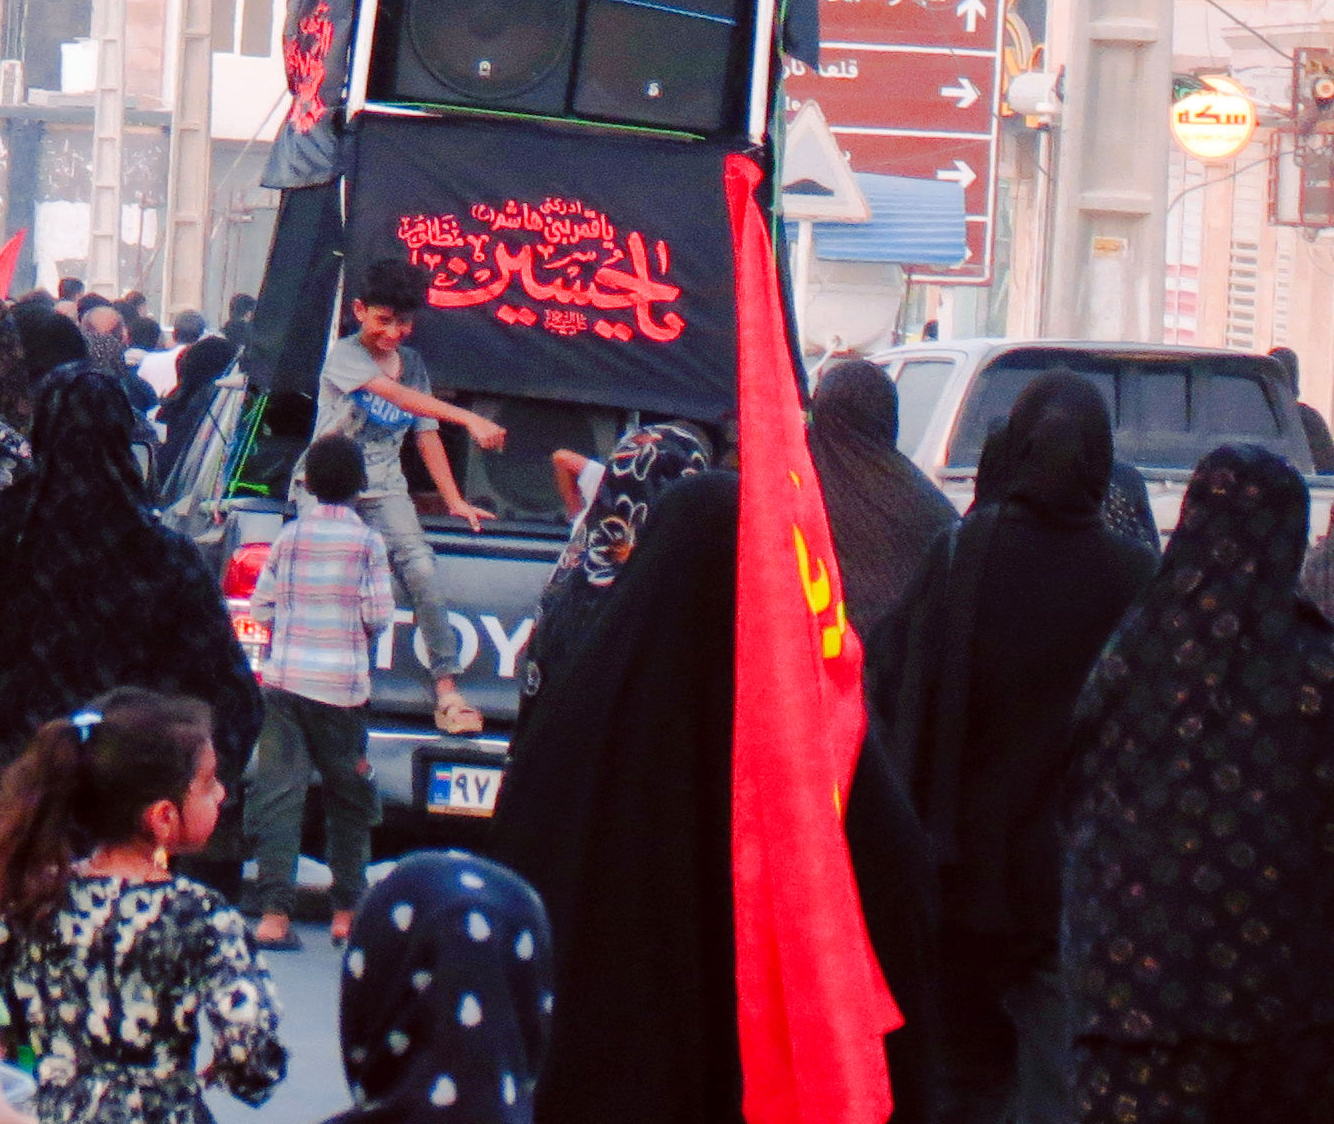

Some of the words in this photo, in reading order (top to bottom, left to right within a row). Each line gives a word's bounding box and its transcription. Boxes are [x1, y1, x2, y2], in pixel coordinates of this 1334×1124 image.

[819, 59, 859, 80] قلع
[1177, 104, 1247, 126] سکه
[376, 609, 536, 678] TOY
